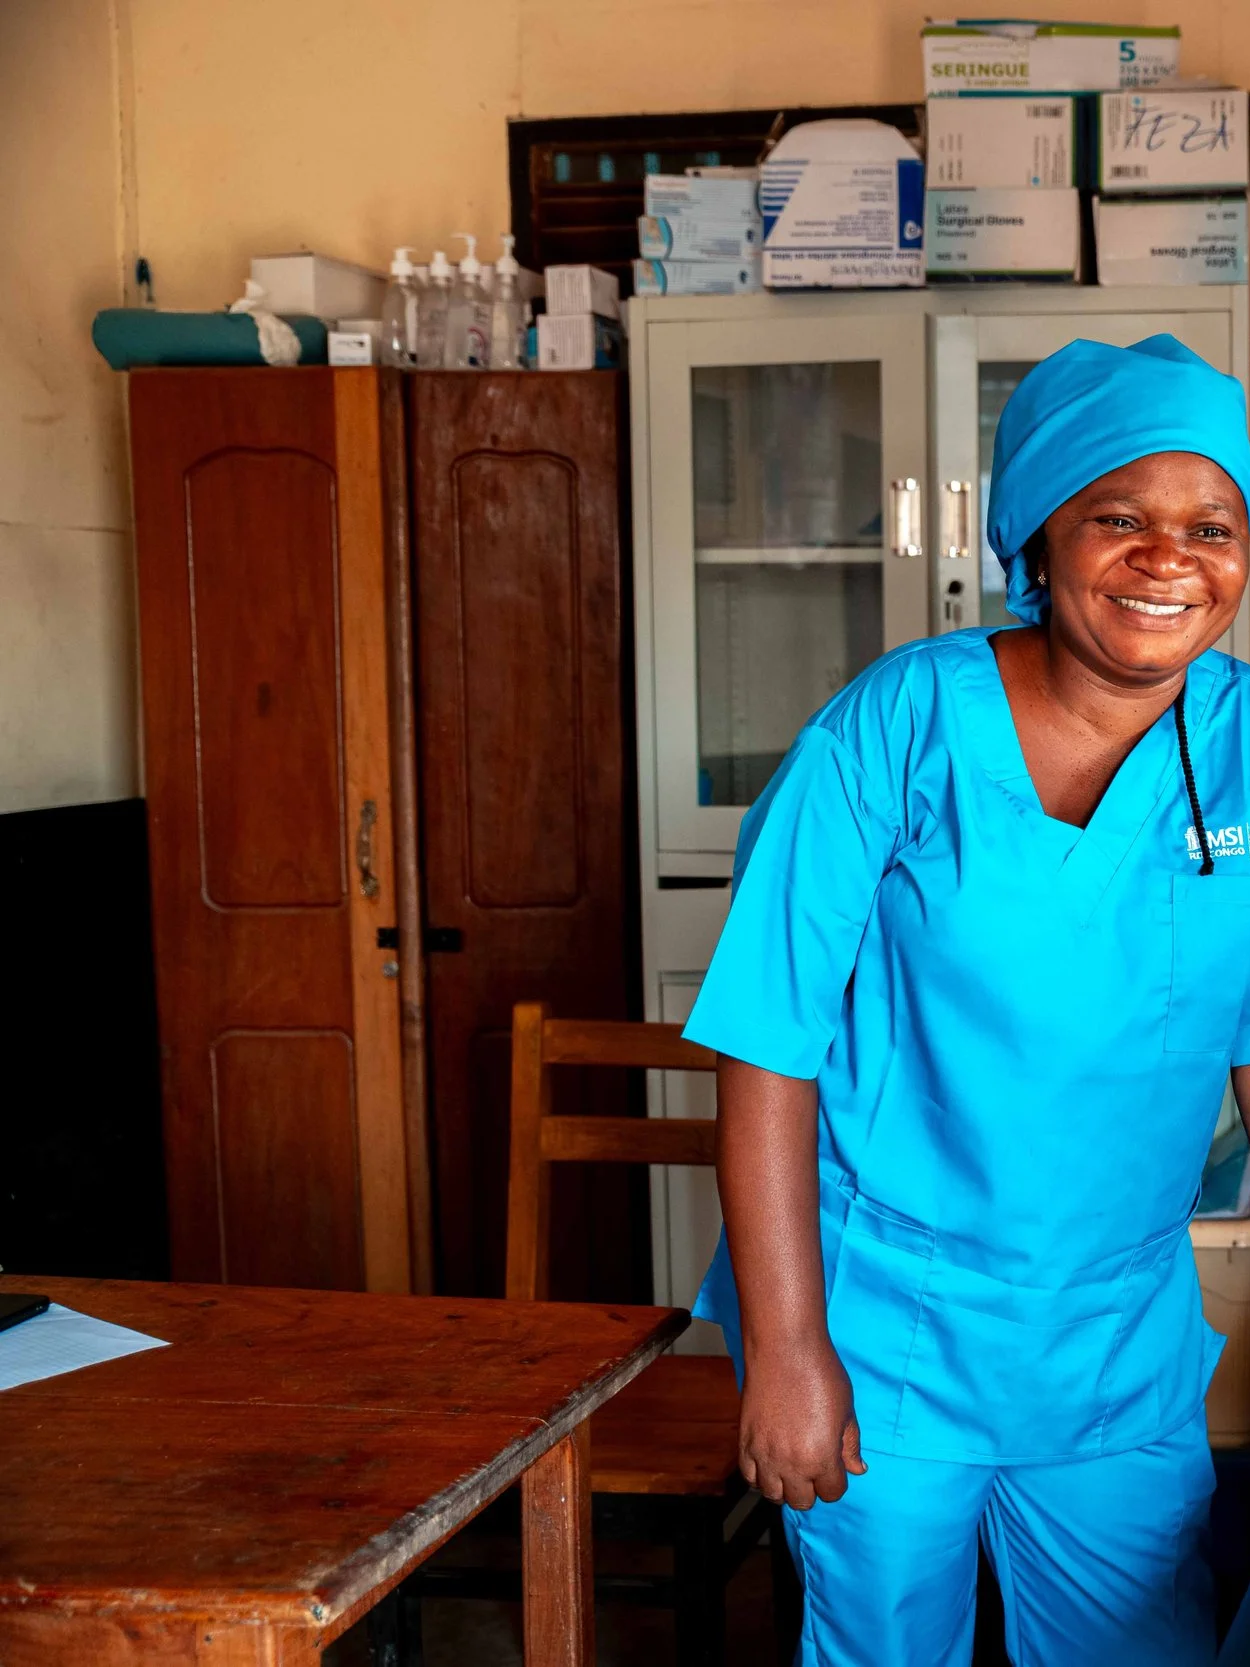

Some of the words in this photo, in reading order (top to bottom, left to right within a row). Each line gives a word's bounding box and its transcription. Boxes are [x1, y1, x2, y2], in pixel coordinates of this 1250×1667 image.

[1120, 41, 1136, 62] 5
[931, 63, 1029, 77] SERINGUE
[936, 216, 984, 228] Surgical
[987, 215, 1024, 226] Gloves
[1206, 826, 1244, 849] MSI
